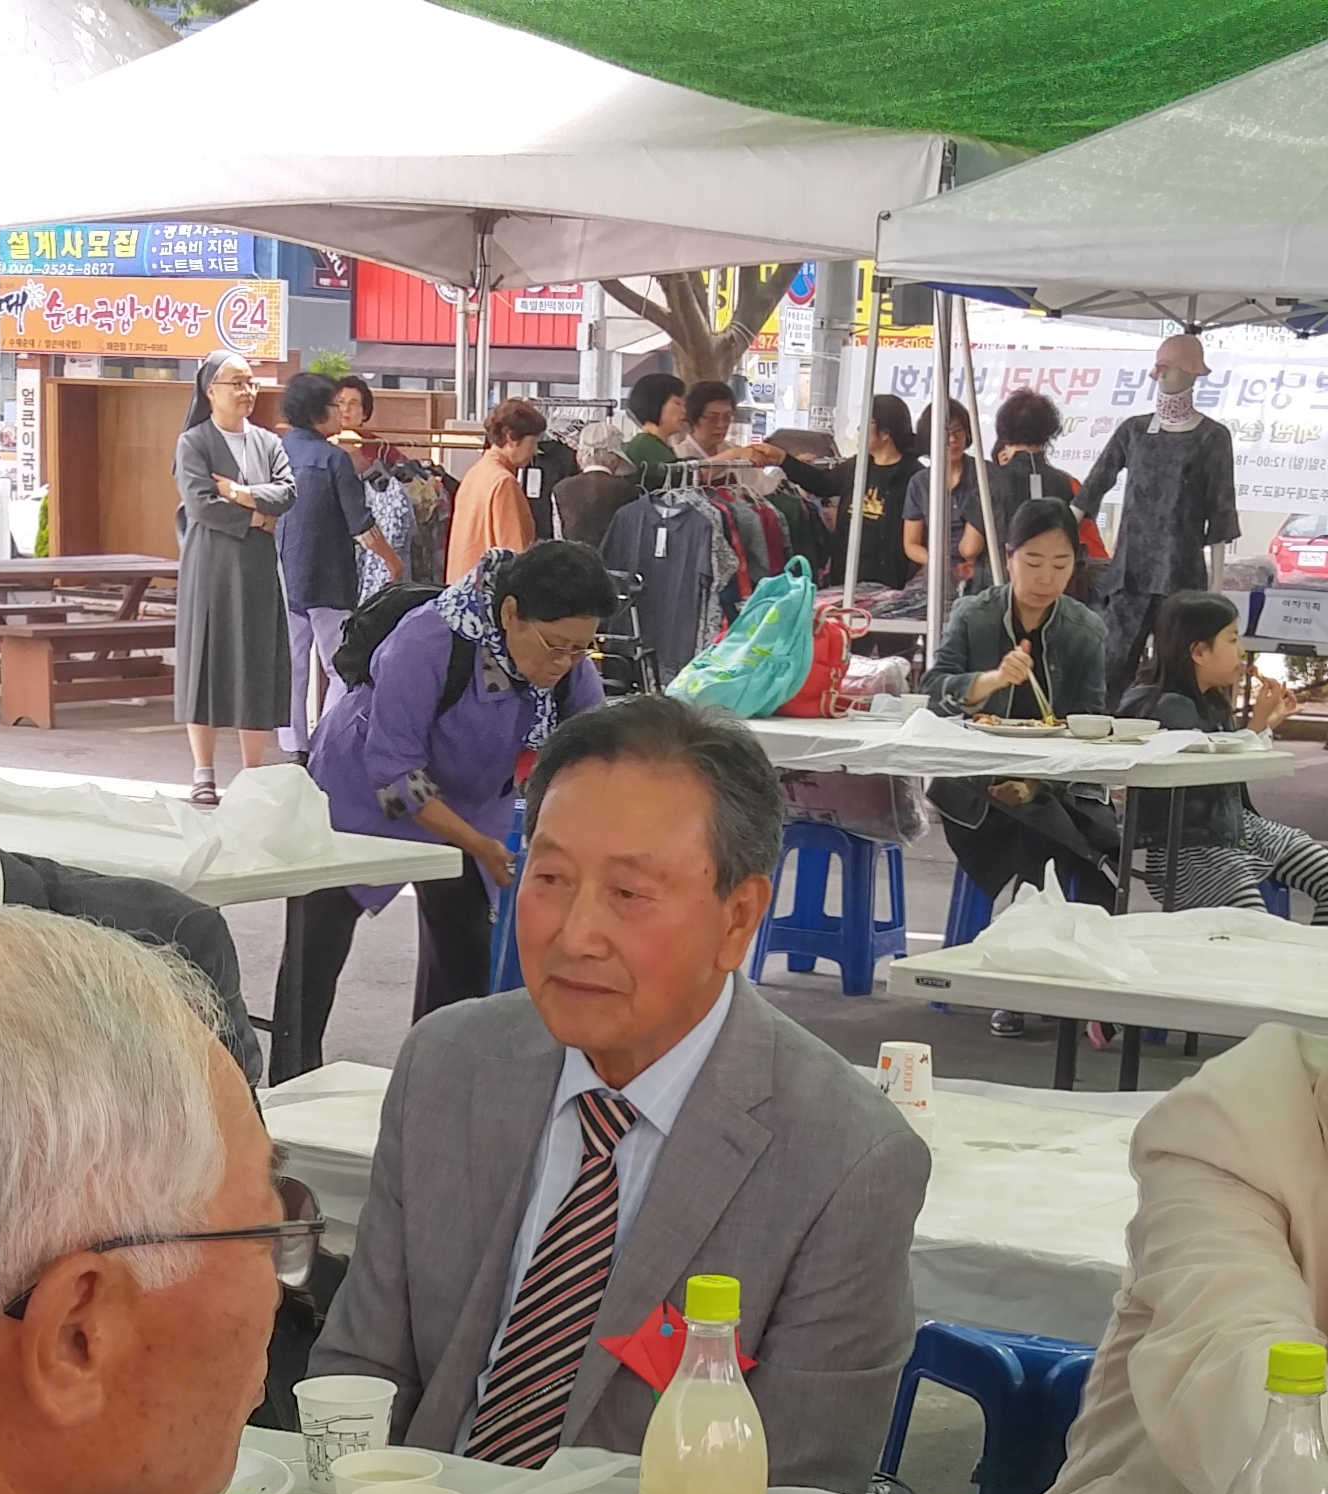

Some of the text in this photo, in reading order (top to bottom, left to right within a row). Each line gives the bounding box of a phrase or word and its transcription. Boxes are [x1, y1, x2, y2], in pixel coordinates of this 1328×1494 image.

[7, 229, 140, 260] 설계사모집
[158, 238, 238, 256] 교육비 지원
[159, 257, 239, 273] 노트북 지급
[230, 297, 269, 332] 24
